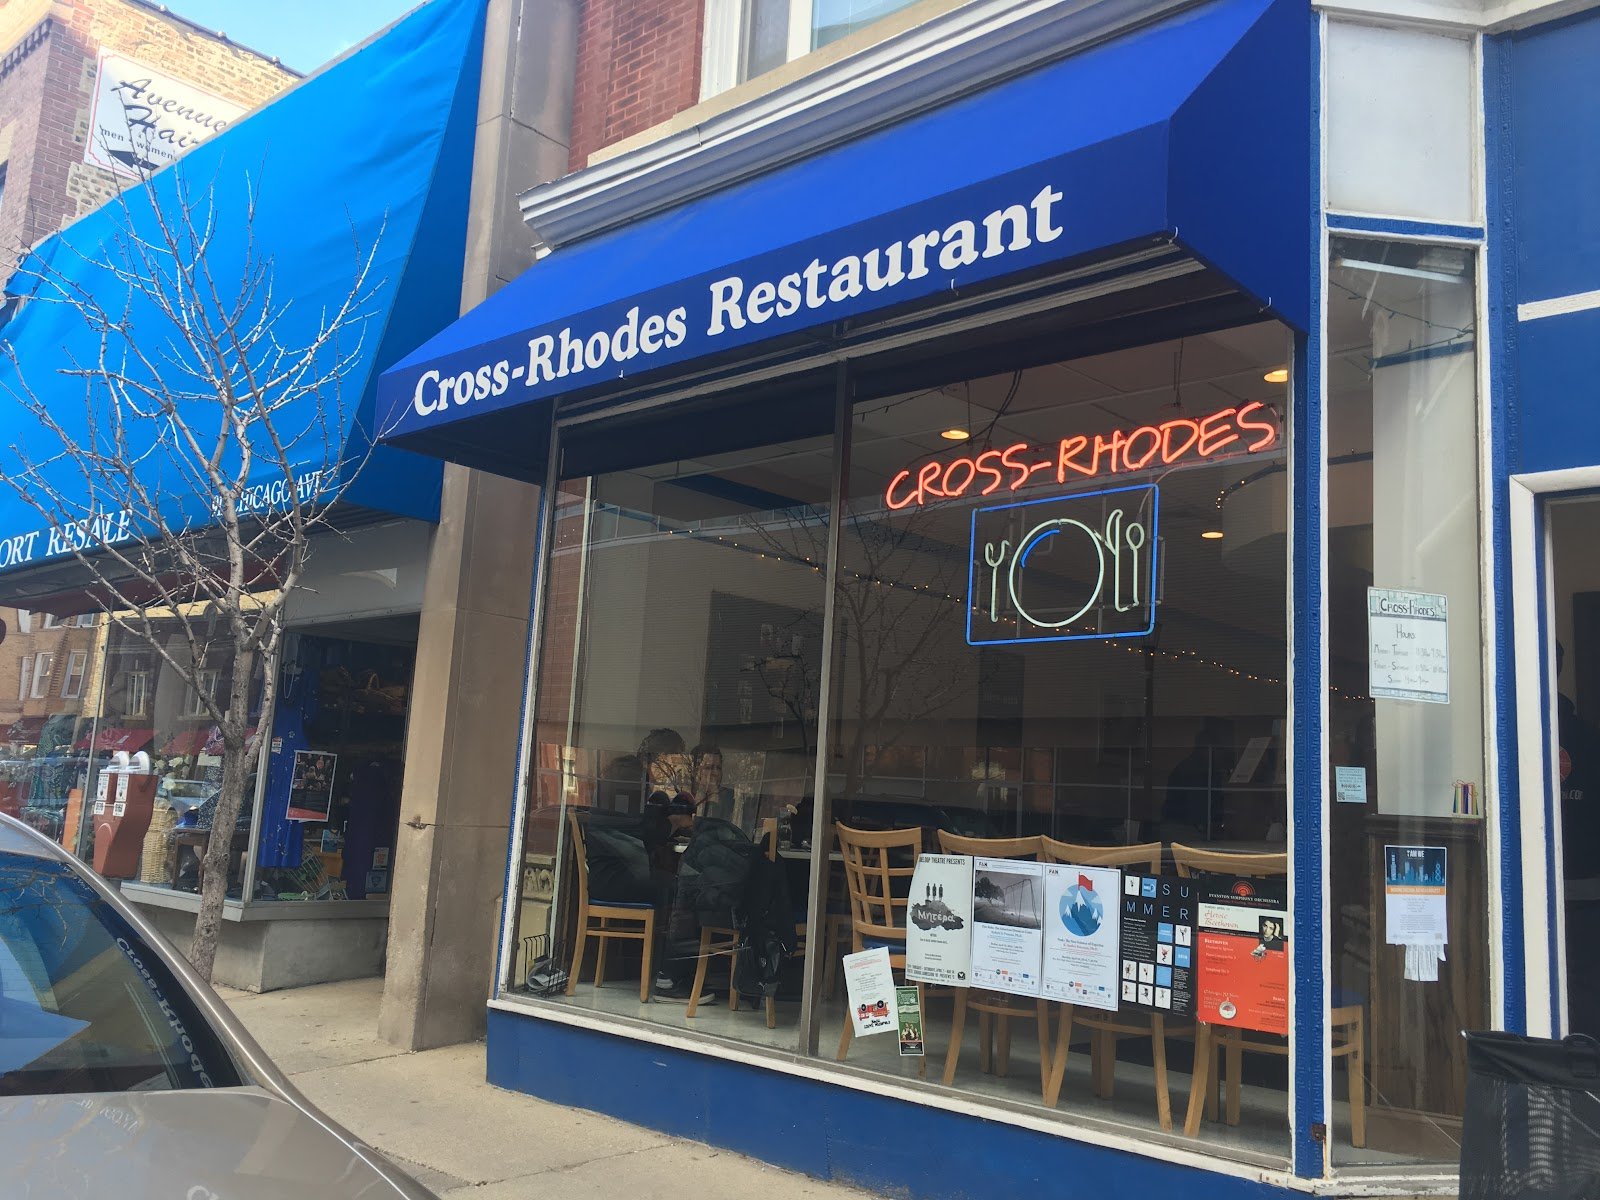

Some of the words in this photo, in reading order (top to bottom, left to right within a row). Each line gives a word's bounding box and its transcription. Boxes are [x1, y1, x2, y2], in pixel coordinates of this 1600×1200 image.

[111, 79, 227, 132] Avenue
[102, 129, 124, 141] men
[413, 305, 687, 418] Cross-Rhodes
[706, 185, 1064, 335] Restaurant
[886, 401, 1276, 509] CROSS-RHODES
[236, 478, 291, 512] HICAGO
[45, 508, 132, 557] RESALE
